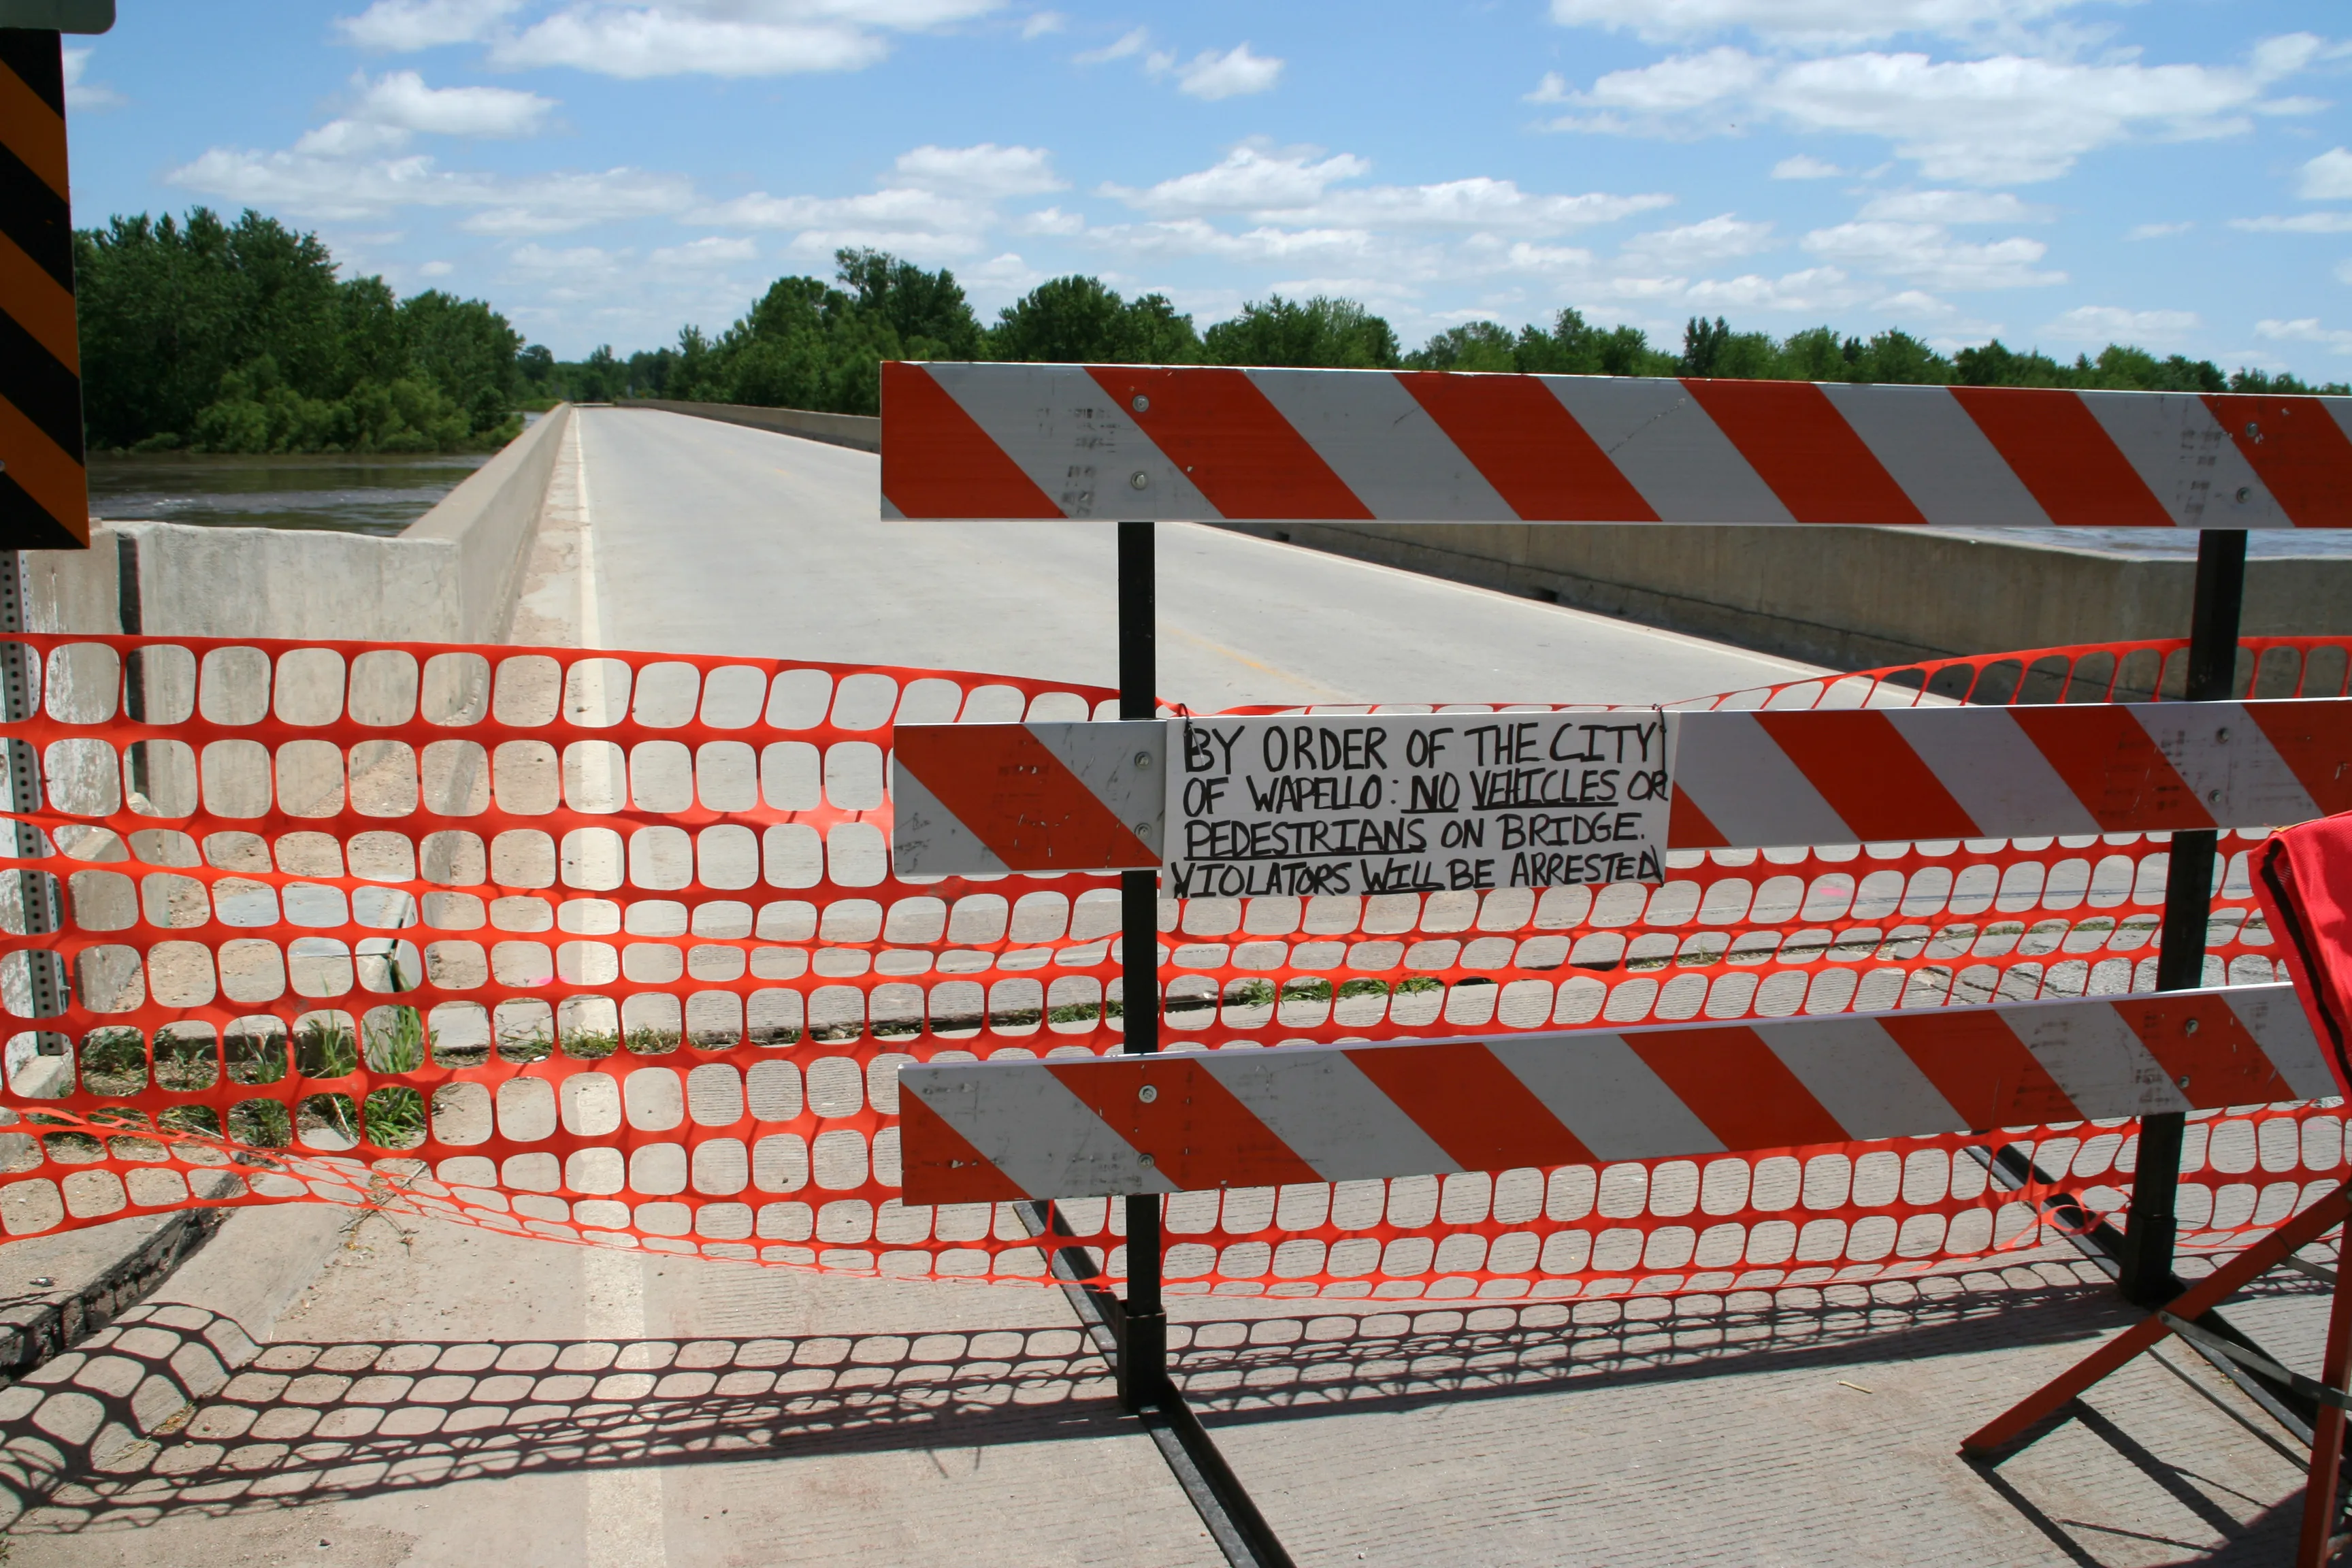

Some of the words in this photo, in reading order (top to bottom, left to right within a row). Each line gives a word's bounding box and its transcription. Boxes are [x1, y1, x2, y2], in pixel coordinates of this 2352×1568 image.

[1184, 725, 1245, 774] BY
[1262, 725, 1388, 772] ORDER
[1406, 728, 1454, 768] OF
[1464, 722, 1545, 766] THE
[1549, 721, 1657, 764] CITY
[1183, 777, 1229, 817] OF
[1409, 771, 1460, 813] NO
[1469, 768, 1620, 810] VEHICLES
[1627, 770, 1669, 802] OR
[1184, 817, 1427, 859] PEDESTRIANS
[1441, 817, 1484, 849] ON
[1496, 811, 1645, 850] BRIDGE.
[1171, 862, 1352, 899] VIOLATORS
[1360, 858, 1446, 895] WILL
[1446, 858, 1496, 891] BE
[1509, 850, 1663, 887] ARRESTED
